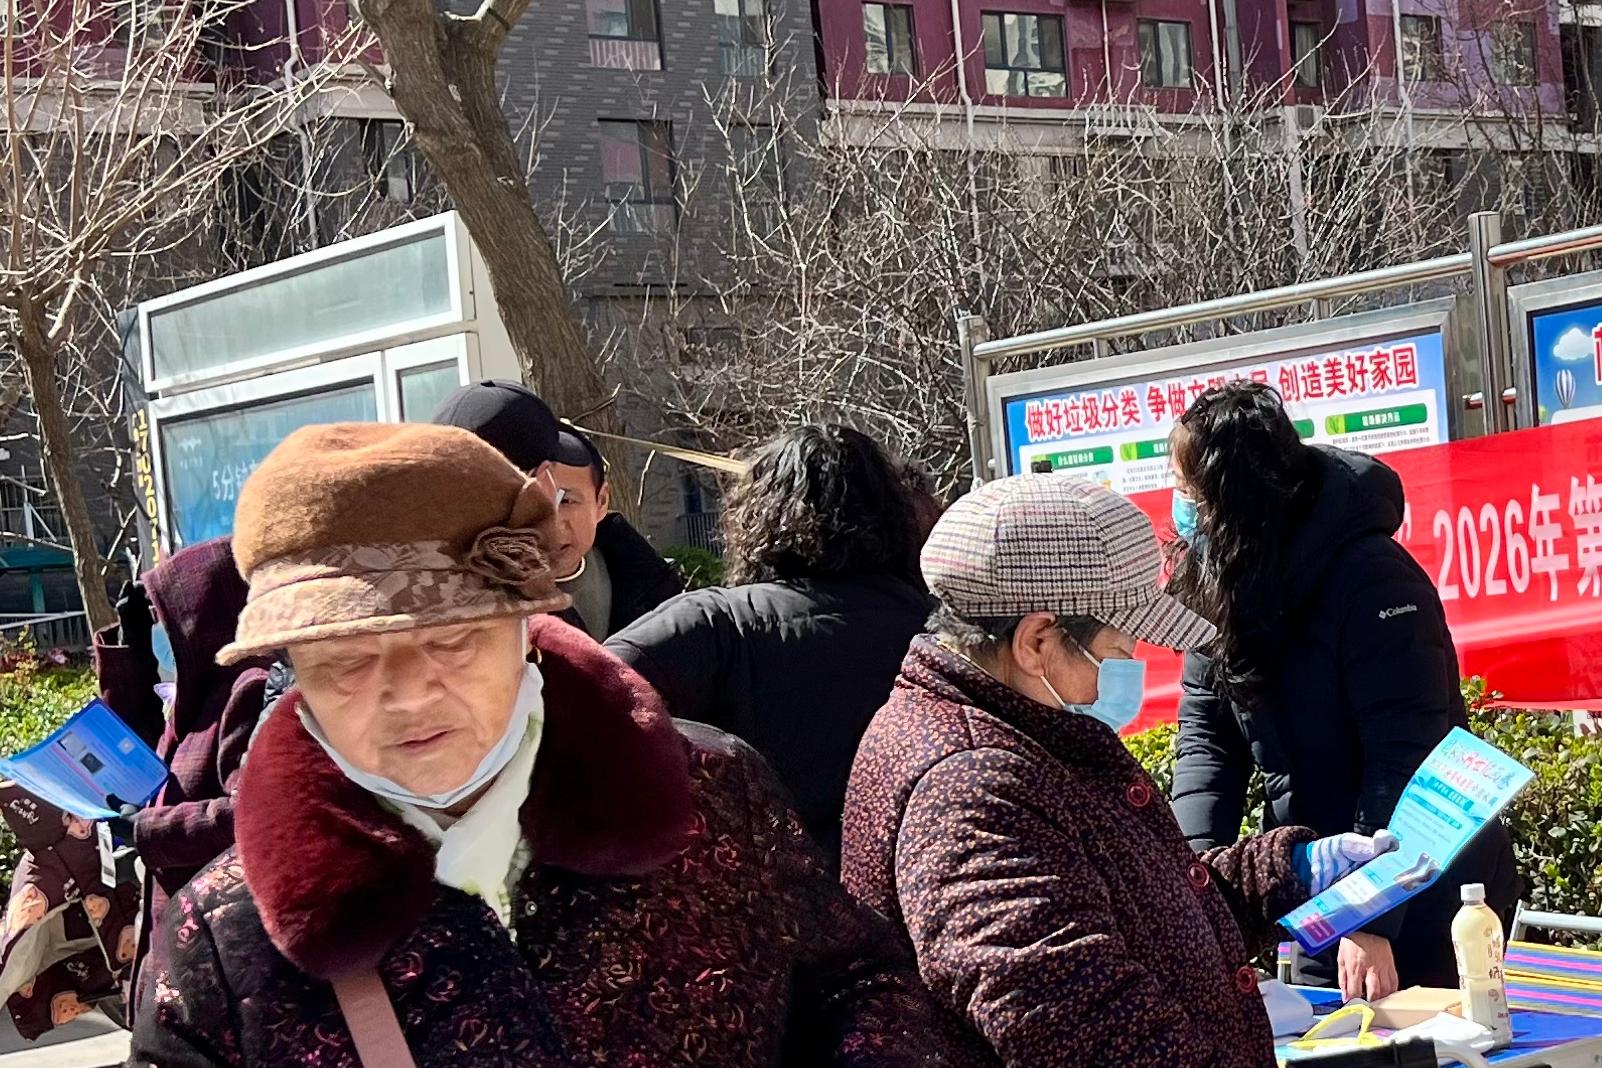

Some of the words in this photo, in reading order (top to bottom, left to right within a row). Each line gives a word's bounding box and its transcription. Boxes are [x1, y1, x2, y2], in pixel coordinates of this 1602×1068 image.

[1025, 387, 1140, 439] 做好垃圾分类
[1147, 369, 1267, 422] 争做文
[1279, 347, 1417, 401] 创造美好家园
